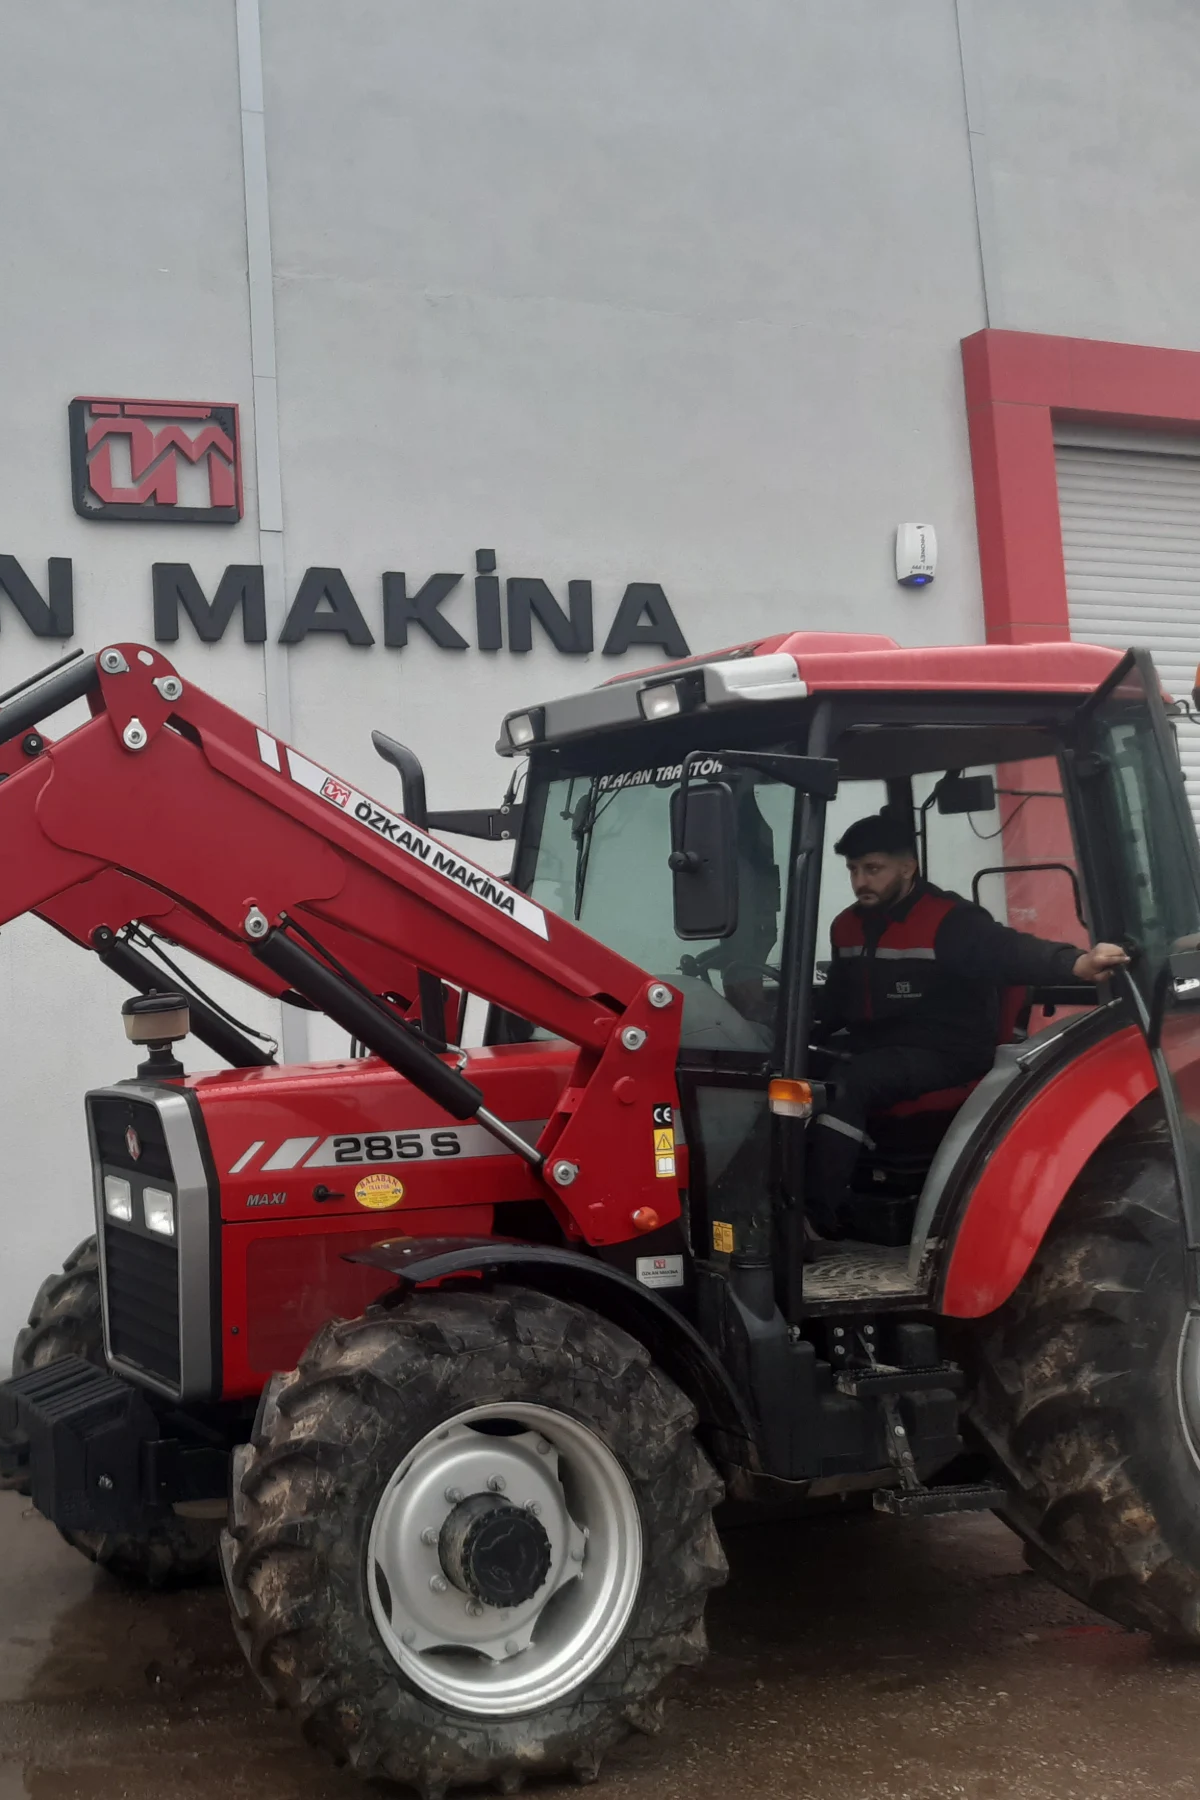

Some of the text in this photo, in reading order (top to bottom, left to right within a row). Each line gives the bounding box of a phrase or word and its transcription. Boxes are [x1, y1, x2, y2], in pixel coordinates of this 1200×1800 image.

[152, 548, 692, 658] MAKİNA
[354, 800, 431, 860] ÖZKAN
[433, 851, 515, 916] MAKİNA
[333, 1131, 462, 1162] 285 S
[359, 1174, 400, 1190] BALABAN
[246, 1192, 287, 1207] MAXI
